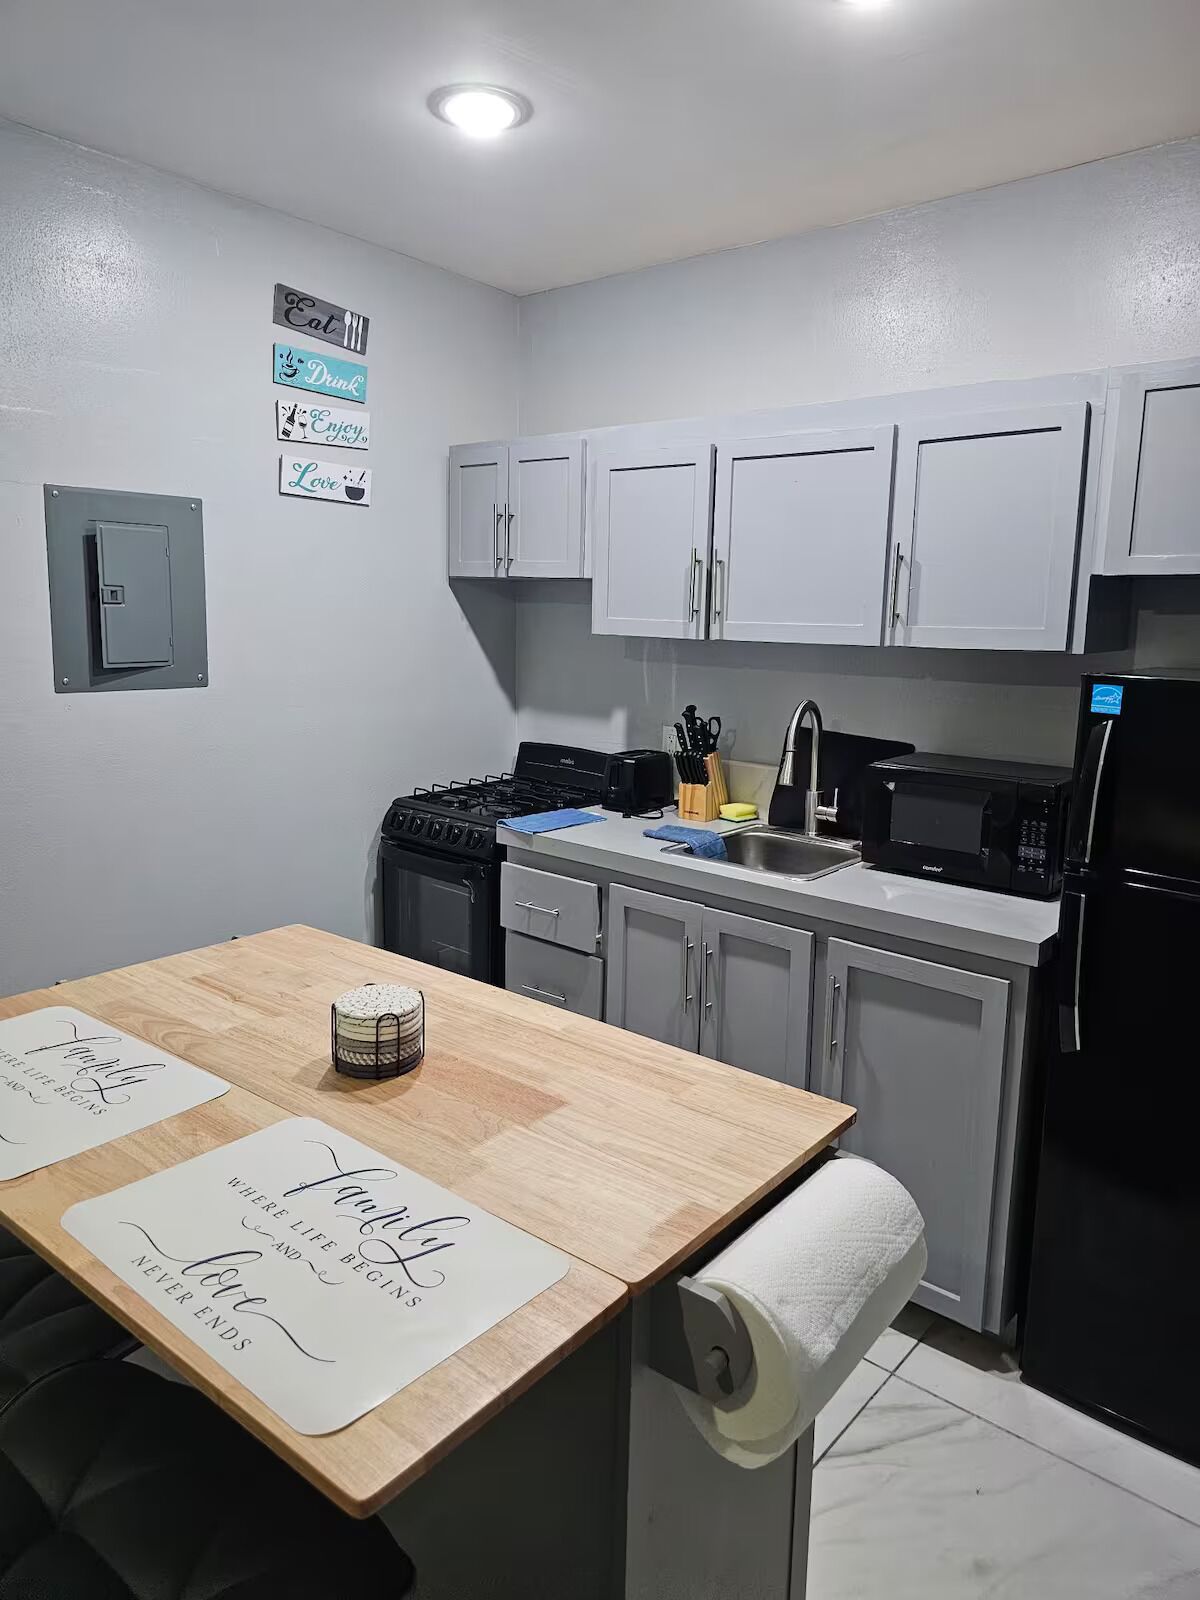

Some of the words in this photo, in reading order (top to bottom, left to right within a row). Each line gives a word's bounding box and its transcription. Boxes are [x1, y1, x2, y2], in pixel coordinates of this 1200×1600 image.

[284, 292, 340, 335] Eat
[304, 359, 364, 396] Drink
[310, 409, 368, 444] Enjoy
[288, 462, 342, 493] Love
[6, 1080, 26, 1092] AND
[23, 1067, 55, 1086] LIFE
[54, 1085, 107, 1116] BEGINS
[227, 1176, 289, 1219] WHERE
[290, 1220, 337, 1252] LIFE
[339, 1252, 422, 1308] BEGINS
[284, 1167, 470, 1289] family
[271, 1240, 302, 1261] AND
[131, 1254, 194, 1304] NEVER
[193, 1305, 252, 1352] ENDS
[181, 1250, 267, 1313] love
